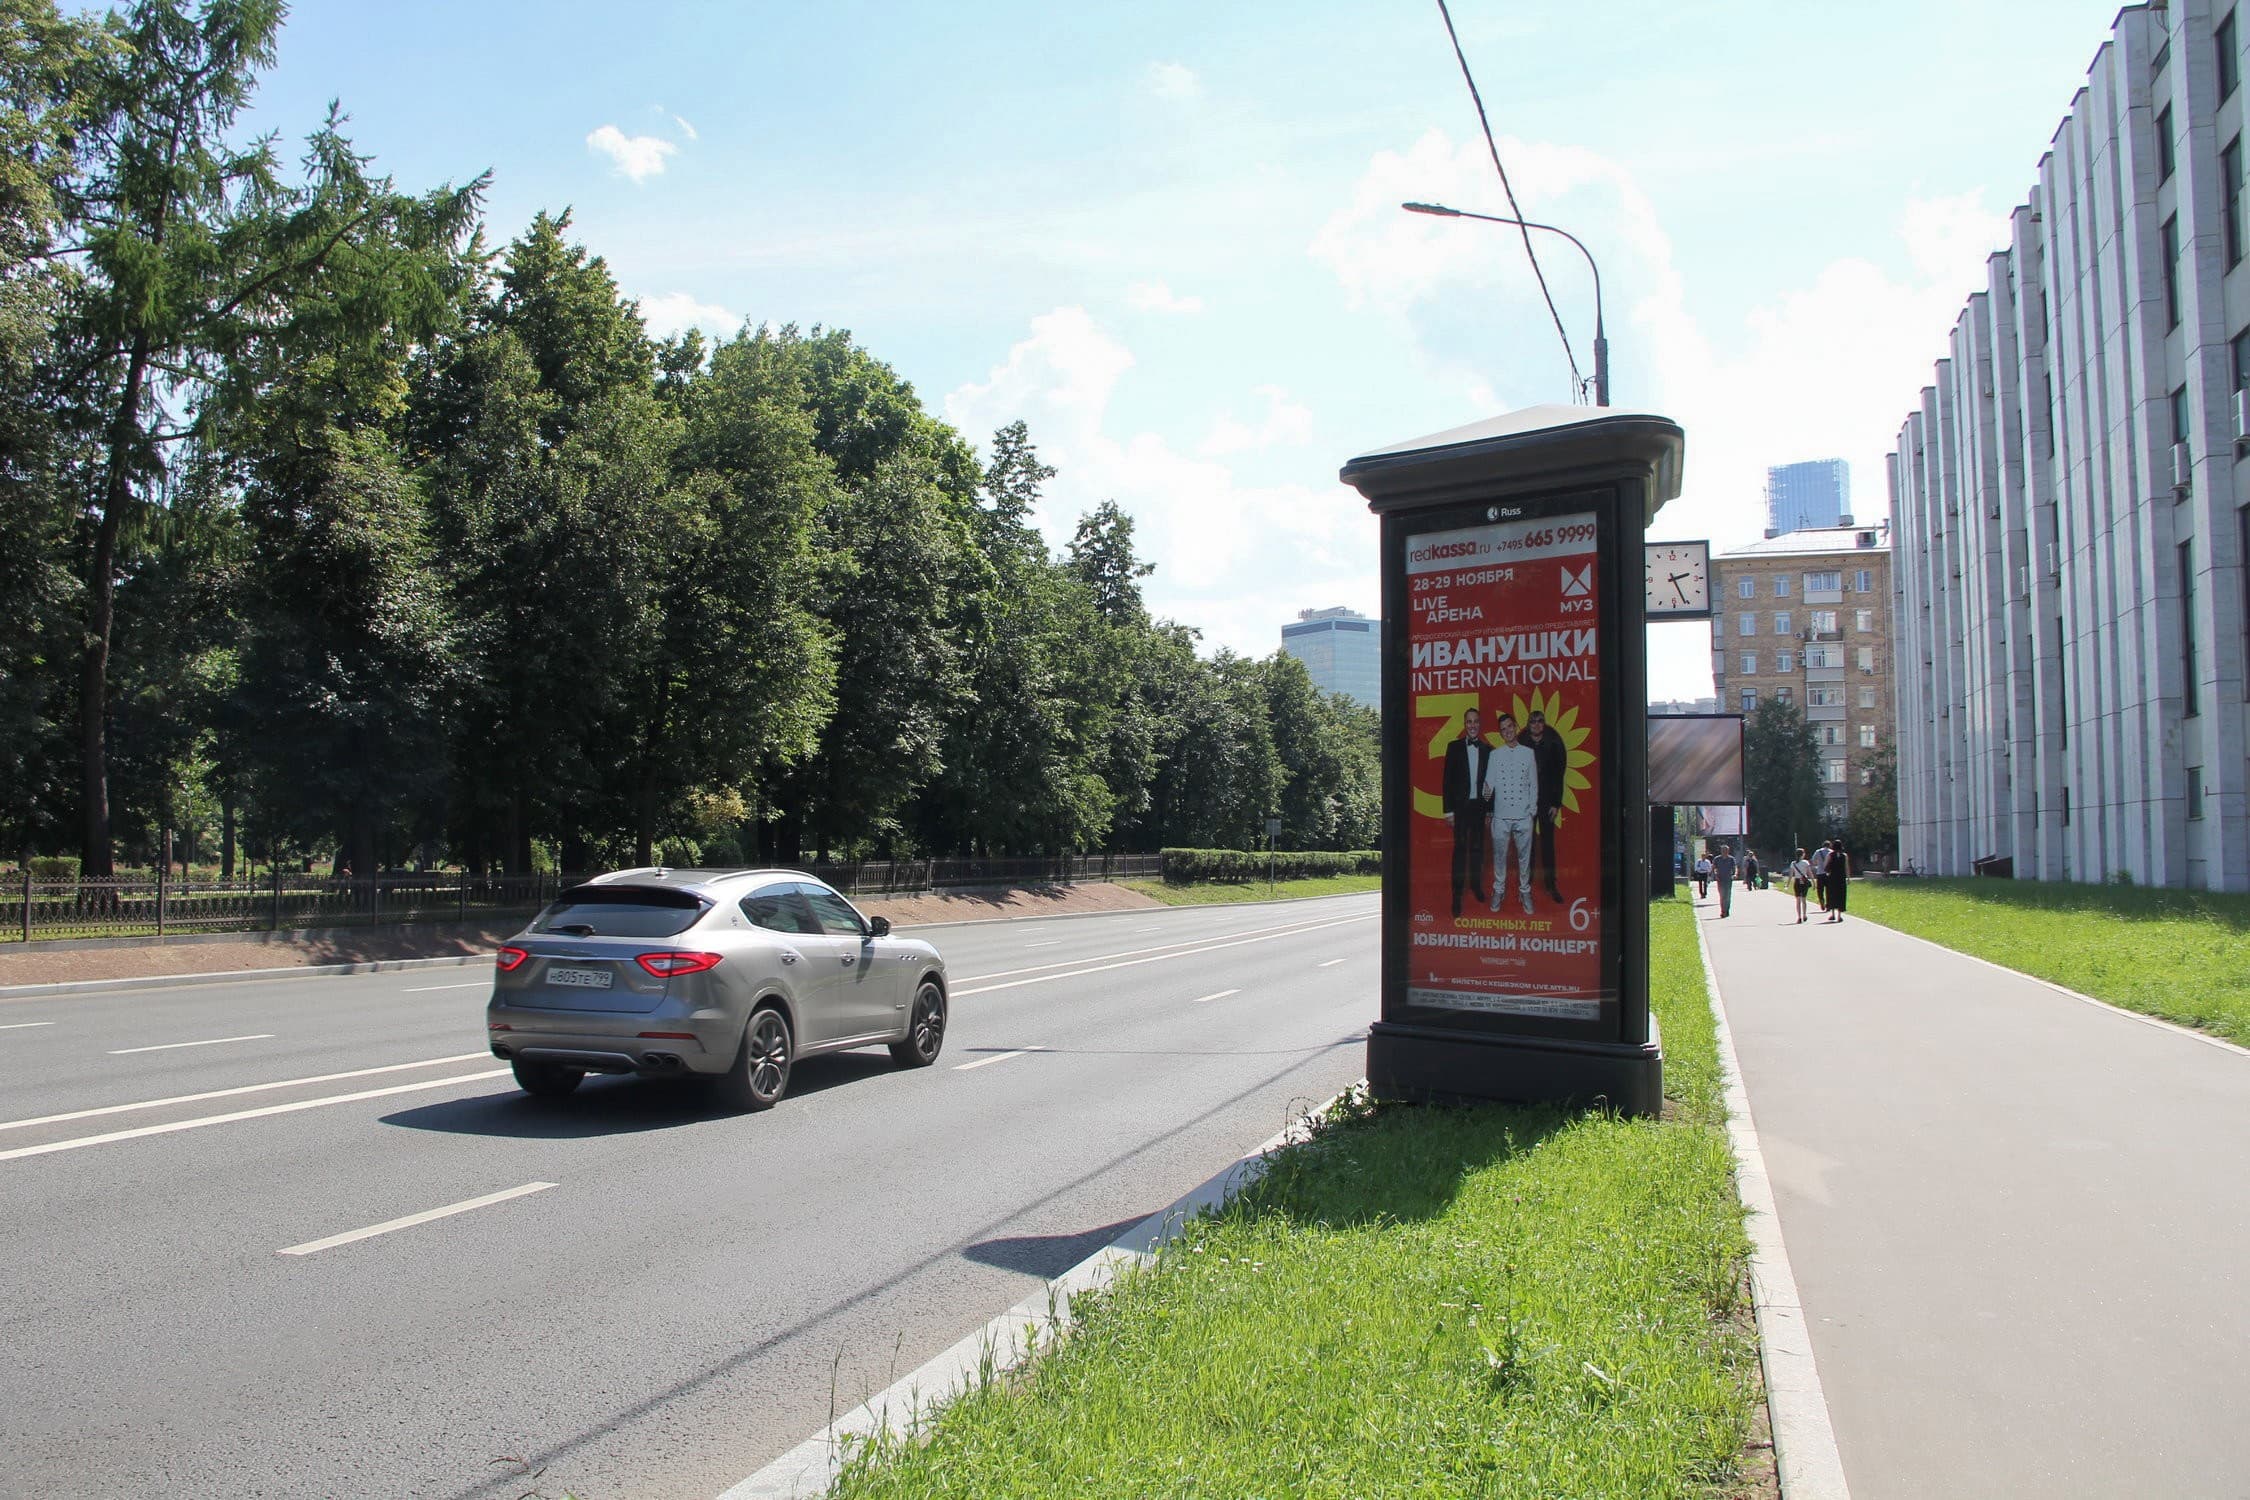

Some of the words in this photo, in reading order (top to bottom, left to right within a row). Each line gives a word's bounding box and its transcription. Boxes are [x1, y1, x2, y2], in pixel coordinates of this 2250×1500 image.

[1501, 507, 1521, 517] Russ
[1525, 529, 1553, 548] 665
[1557, 523, 1595, 544] 9999
[1413, 576, 1450, 591] 28-29
[1456, 568, 1514, 586] НОЯБРЯ
[1413, 596, 1448, 611] LIVE
[1426, 606, 1483, 624] АРЕНА
[1560, 600, 1593, 613] МУЗ
[1412, 628, 1596, 669] ИВАНУШКИ
[1412, 660, 1596, 692] INTERNATIONAL
[1454, 917, 1526, 931] СОЛНЕЧНЫХ
[1529, 919, 1552, 931] ЛЕТ
[1569, 897, 1600, 931] 6+
[1414, 932, 1516, 950] ЮБИЛЕЙНЫЙ
[1520, 937, 1598, 955] КОНЦЕРТ
